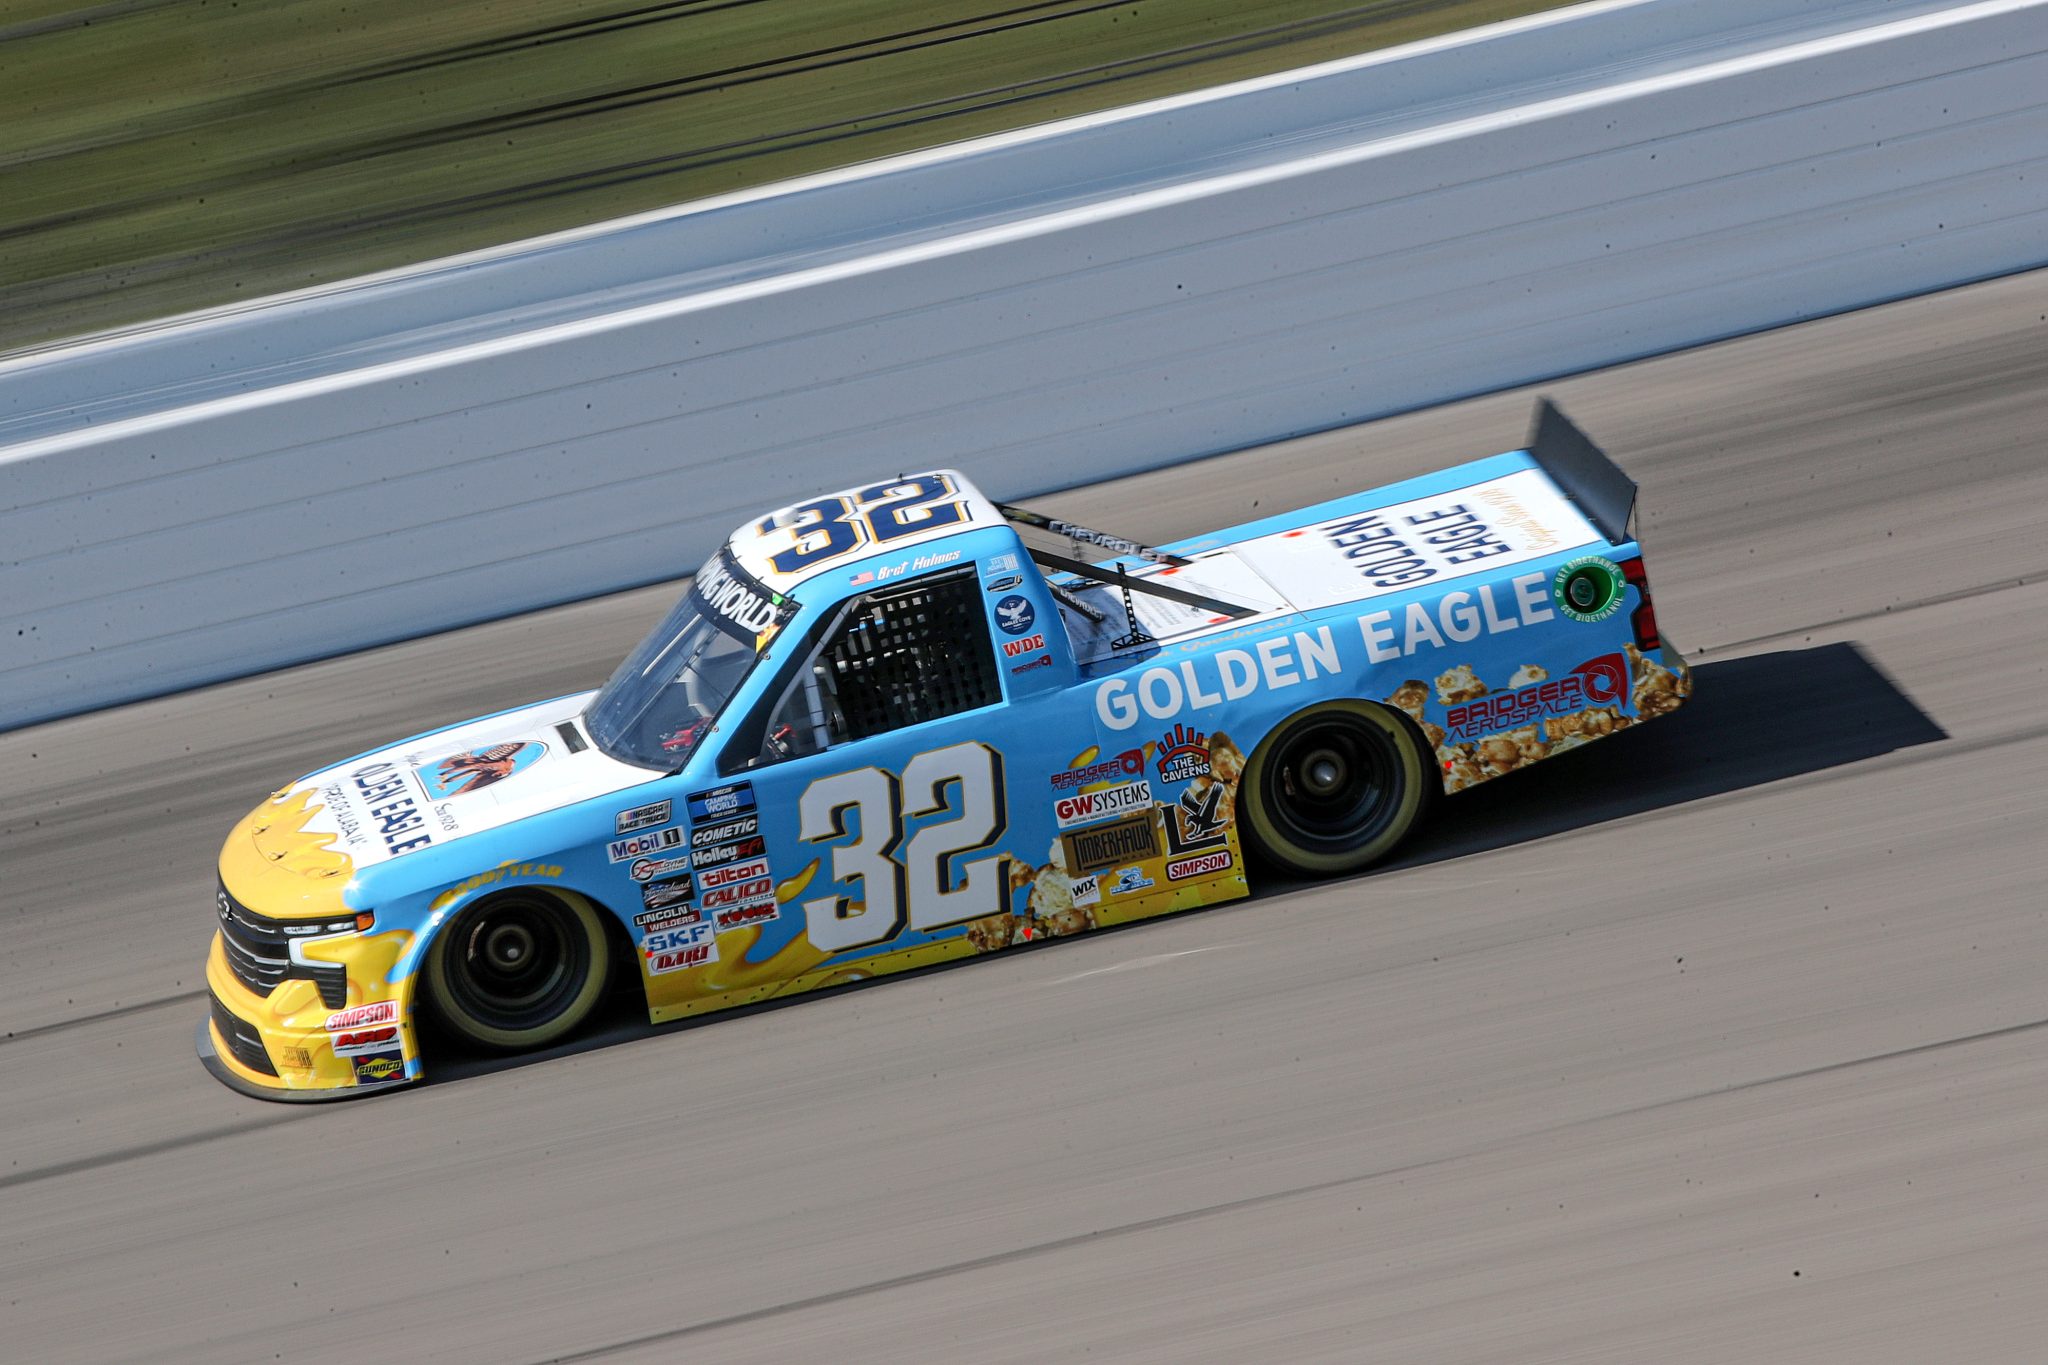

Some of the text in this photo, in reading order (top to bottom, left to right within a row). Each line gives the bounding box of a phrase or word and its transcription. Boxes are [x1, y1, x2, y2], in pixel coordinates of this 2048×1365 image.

[756, 473, 974, 576] 32
[1403, 504, 1513, 566] EAGLE
[912, 549, 961, 571] Holmes
[1320, 514, 1438, 588] GOLDEN
[1555, 556, 1620, 583] GET BIOETHANOL
[709, 576, 777, 633] WORLD
[1560, 596, 1624, 623] GET BIOETHANOL
[1003, 634, 1046, 657] WDE
[1095, 571, 1555, 731] GOLDEN EAGLE
[1446, 676, 1582, 729] BRIDGER
[1449, 694, 1584, 742] AEROSPACE
[1051, 760, 1121, 786] BRIDGER
[1161, 762, 1211, 784] CAVERNS
[1172, 755, 1195, 771] THE
[1051, 769, 1121, 792] AEROSPACE
[628, 804, 665, 820] NASCAR
[706, 800, 738, 814] WORLD
[371, 797, 432, 855] EAGLE
[618, 812, 669, 831] RACE TRUCK
[692, 819, 757, 845] COMETIC
[611, 834, 661, 859] Mobil
[691, 845, 740, 867] Holley
[799, 740, 1011, 953] 32
[703, 863, 766, 886] tilton
[1171, 854, 1228, 878] SIMPSON
[703, 877, 772, 908] CALICO
[1072, 877, 1096, 896] WIX
[636, 904, 688, 926] LINCOLN
[649, 914, 695, 932] WELDERS
[647, 925, 710, 952] SKF
[328, 1003, 394, 1029] SIMPSON
[357, 1059, 401, 1076] SUNOCO
